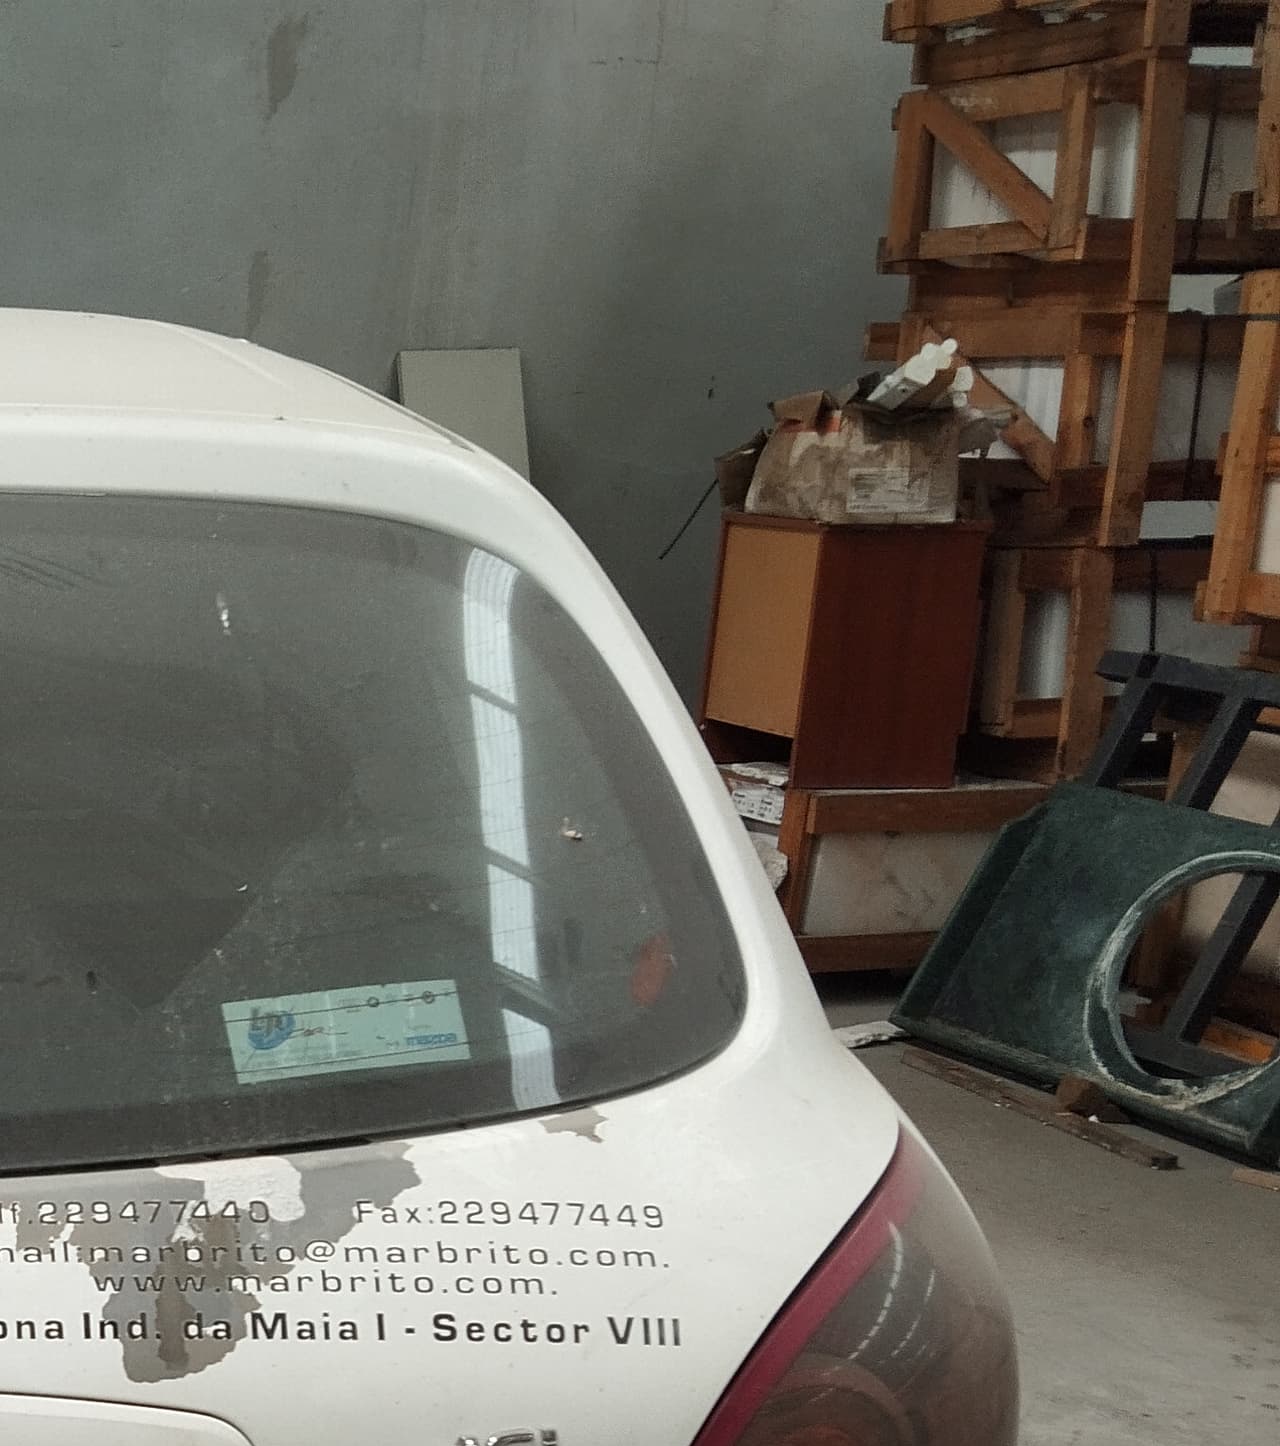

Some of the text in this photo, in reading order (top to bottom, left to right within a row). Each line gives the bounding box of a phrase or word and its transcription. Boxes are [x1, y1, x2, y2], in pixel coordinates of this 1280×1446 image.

[82, 1312, 162, 1341] Ind.
[183, 1312, 233, 1341] da
[250, 1311, 360, 1342] Maia
[432, 1312, 591, 1344] Sector
[606, 1315, 682, 1347] VIII
